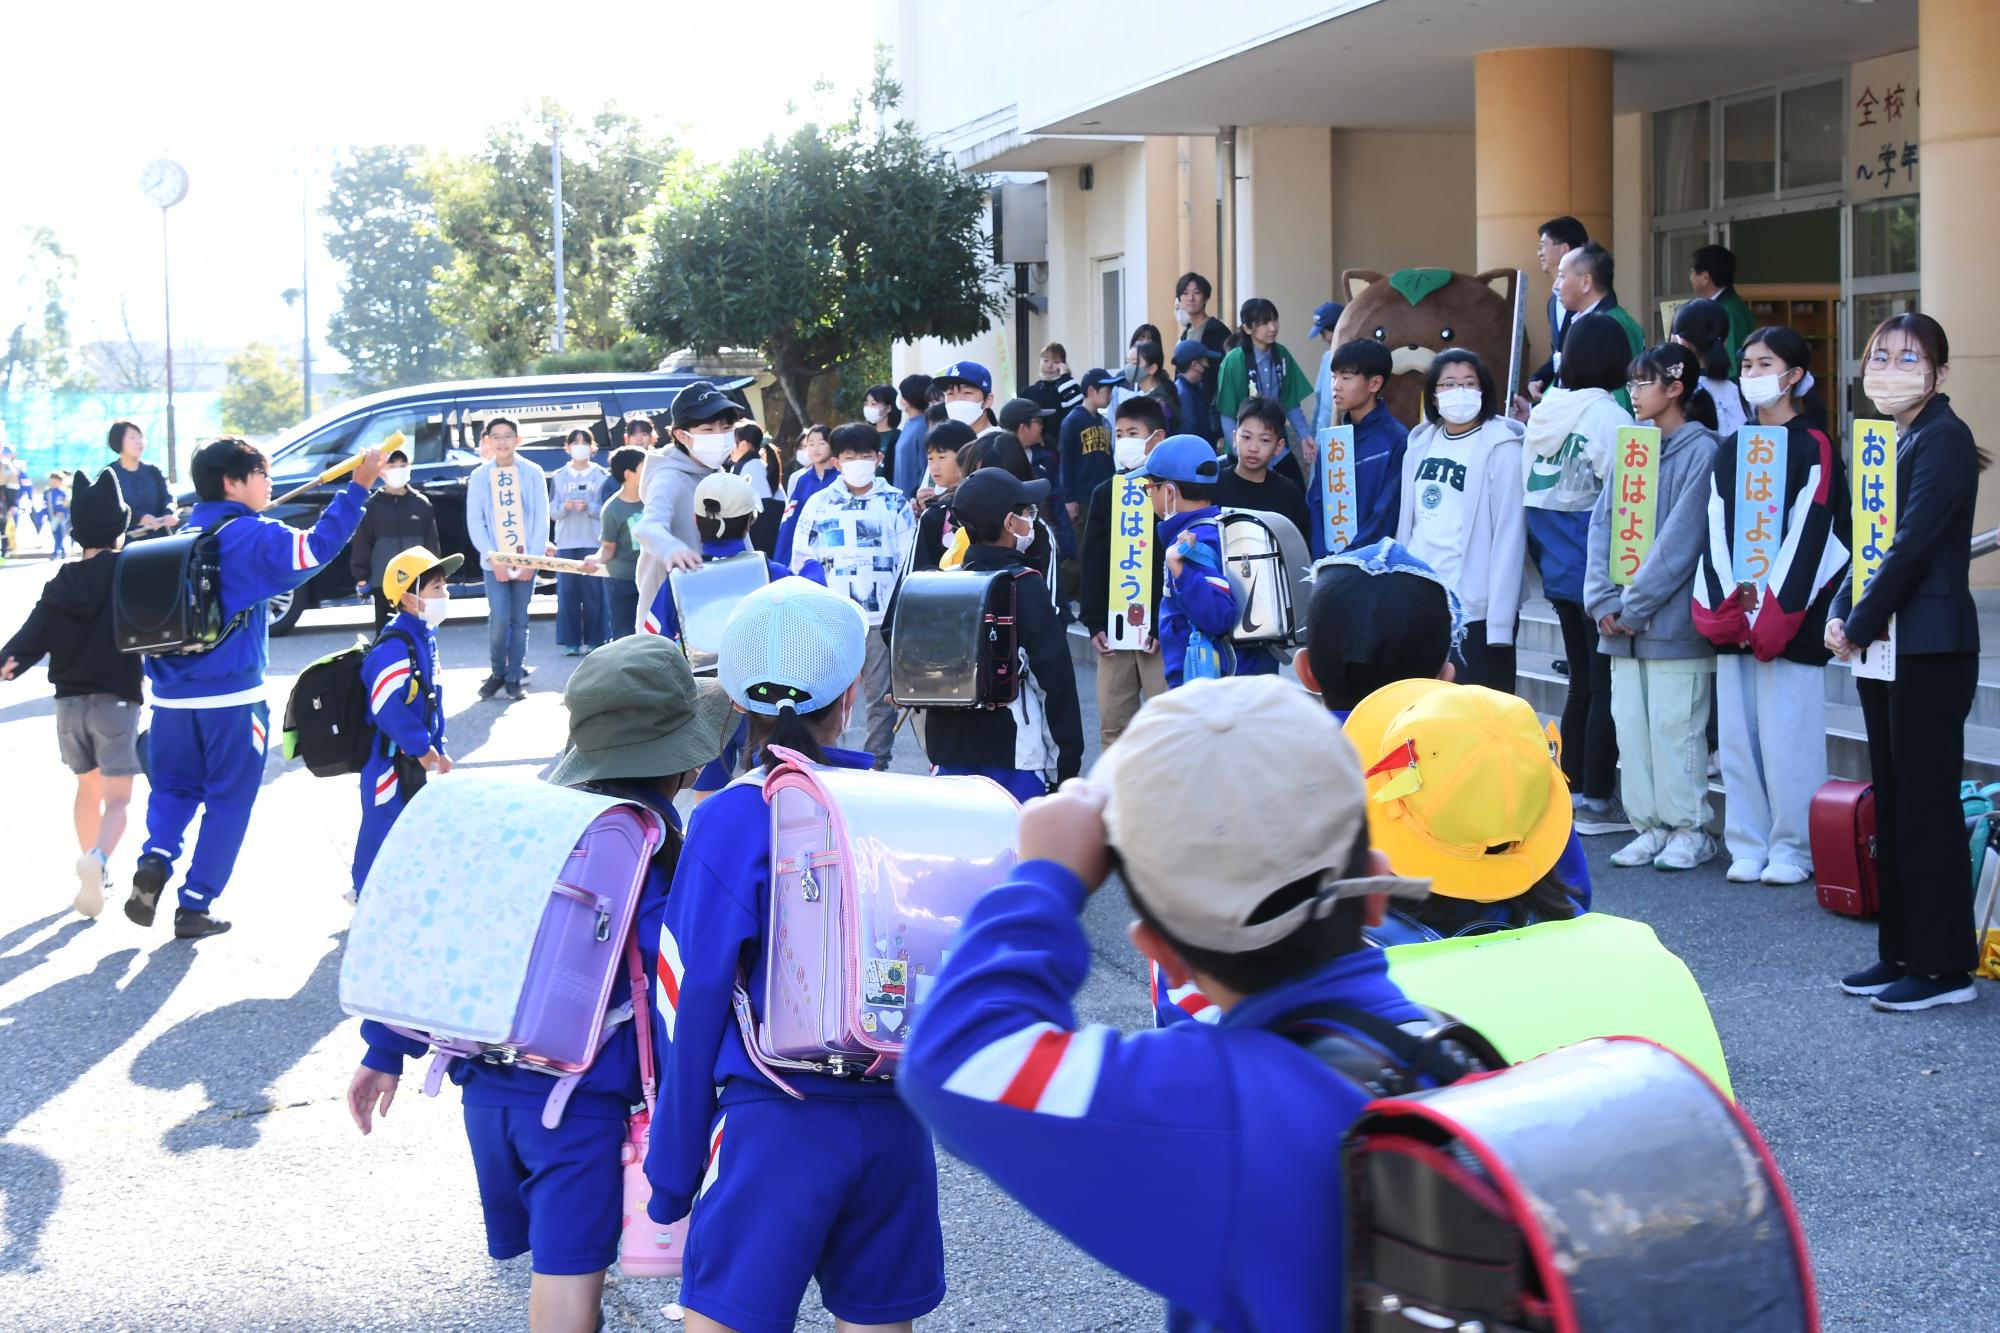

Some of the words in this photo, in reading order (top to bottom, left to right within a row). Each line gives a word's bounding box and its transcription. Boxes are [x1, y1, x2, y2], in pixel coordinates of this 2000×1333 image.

[1856, 83, 1920, 127] 全校
[498, 470, 519, 546] おはよう
[1119, 480, 1146, 600] おはよう
[1327, 437, 1349, 553] おはよう
[1619, 438, 1649, 576] おはよう
[1744, 433, 1776, 579] おはよう
